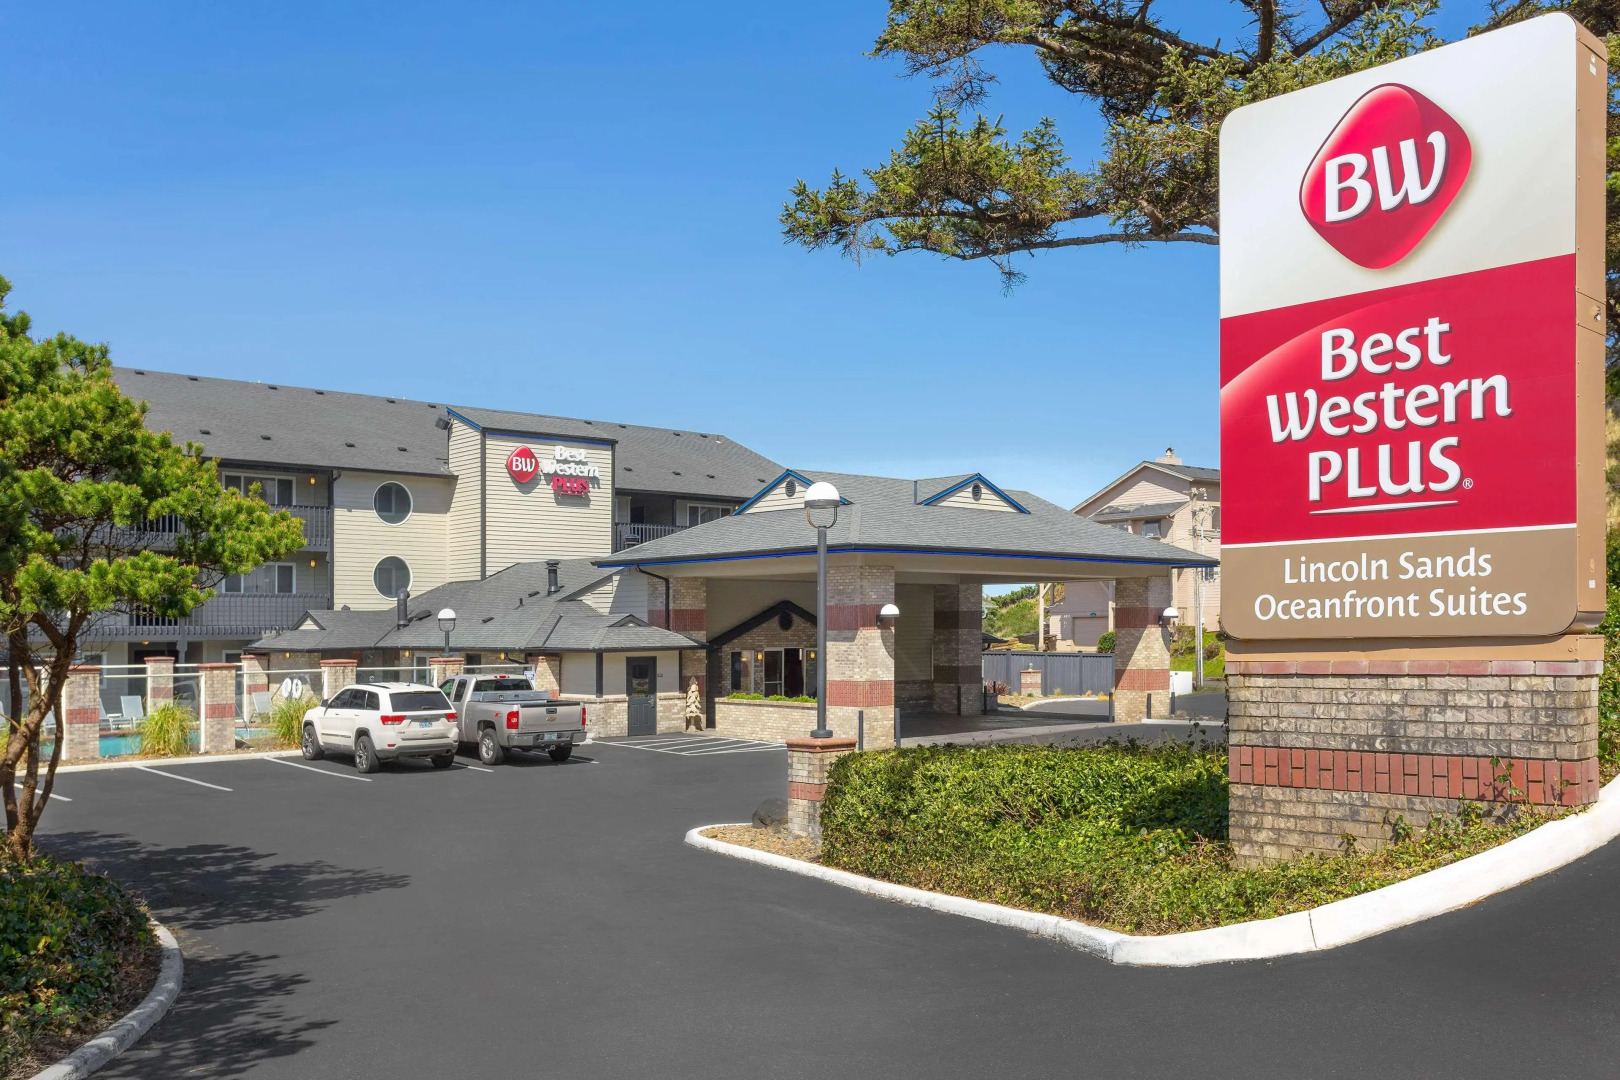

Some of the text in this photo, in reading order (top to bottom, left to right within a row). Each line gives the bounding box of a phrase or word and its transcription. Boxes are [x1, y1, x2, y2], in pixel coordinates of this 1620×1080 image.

[1324, 130, 1449, 223] BW
[1320, 316, 1453, 382] Best
[1265, 373, 1514, 444] Western
[512, 457, 535, 472] BW
[541, 460, 598, 476] Western
[555, 446, 587, 461] Best
[552, 476, 589, 492] PLUS
[1283, 546, 1493, 585] Lincoln Sands
[1253, 586, 1529, 622] Oceanfront Suites
